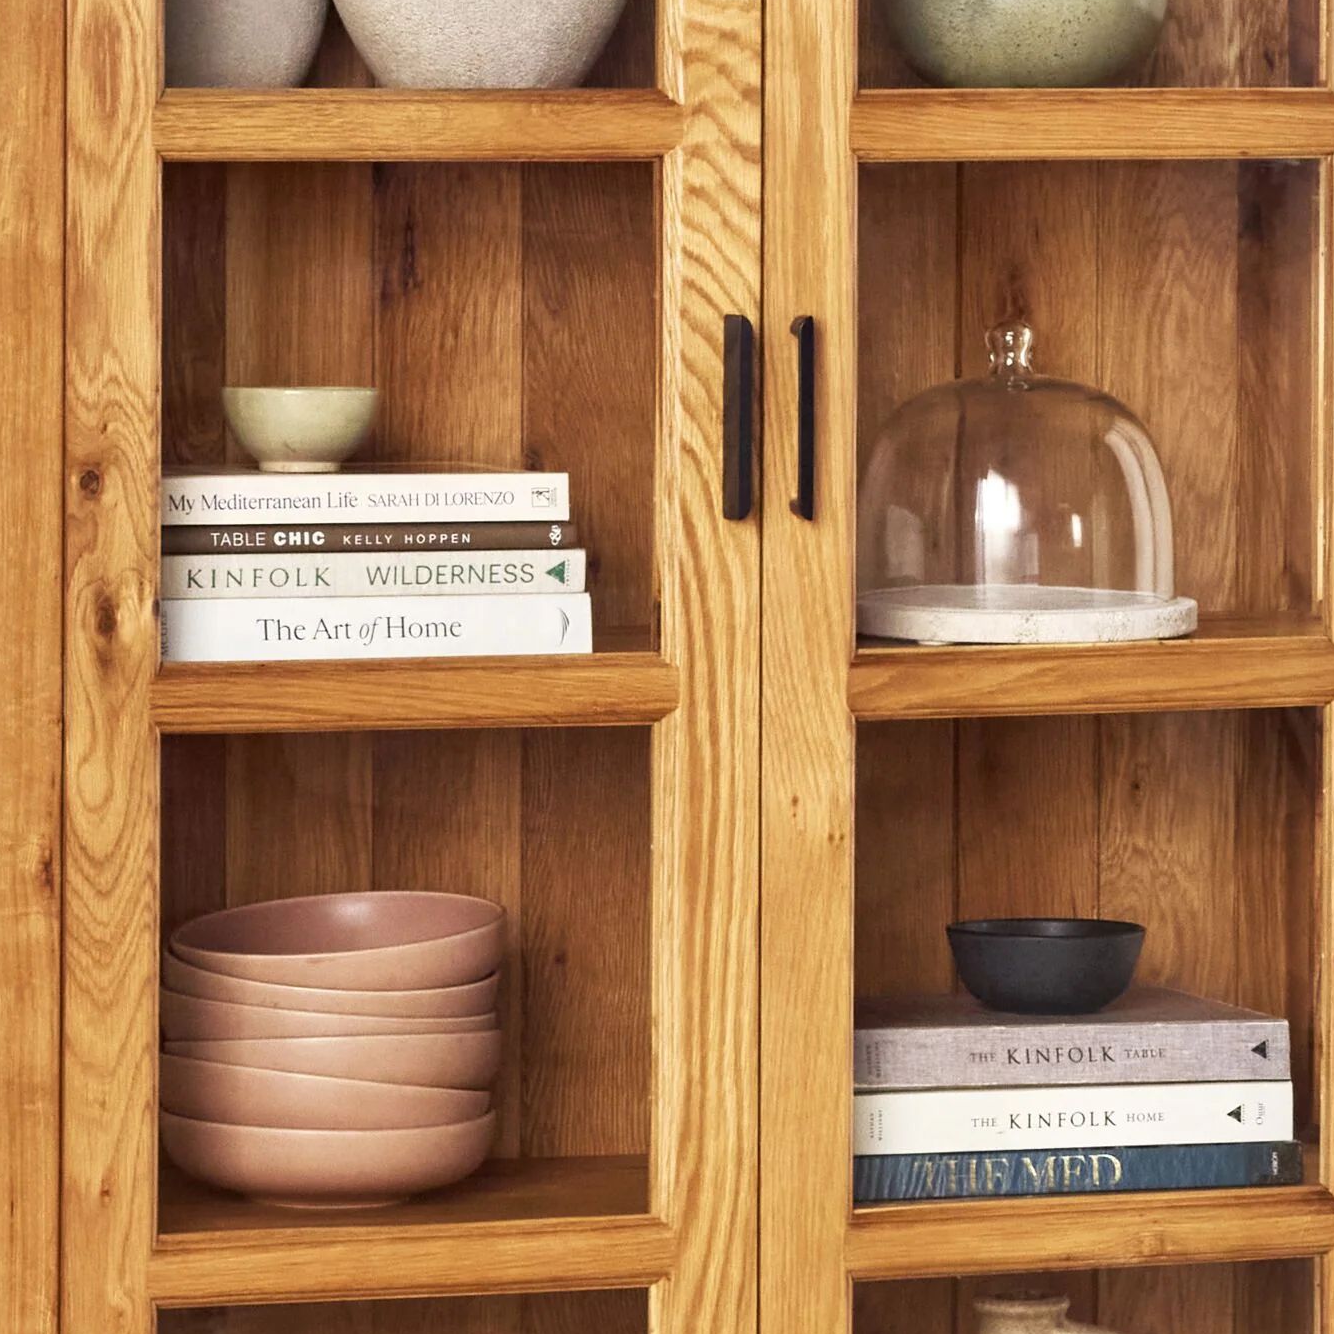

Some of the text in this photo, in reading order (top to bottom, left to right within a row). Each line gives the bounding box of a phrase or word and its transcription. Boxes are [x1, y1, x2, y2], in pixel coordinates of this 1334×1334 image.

[167, 491, 359, 516] My Mediterranean Life
[367, 490, 515, 508] SARAH DI LORENZO
[210, 530, 326, 547] TABLE CHIC
[342, 532, 471, 546] KELLY HOPPEN
[186, 562, 535, 589] KINFOLK WILDERNESS
[256, 616, 463, 646] The Art of Home
[968, 1051, 997, 1064] THE
[1006, 1045, 1116, 1065] KINFOLK
[970, 1110, 1165, 1130] THE KINFOLK HOME
